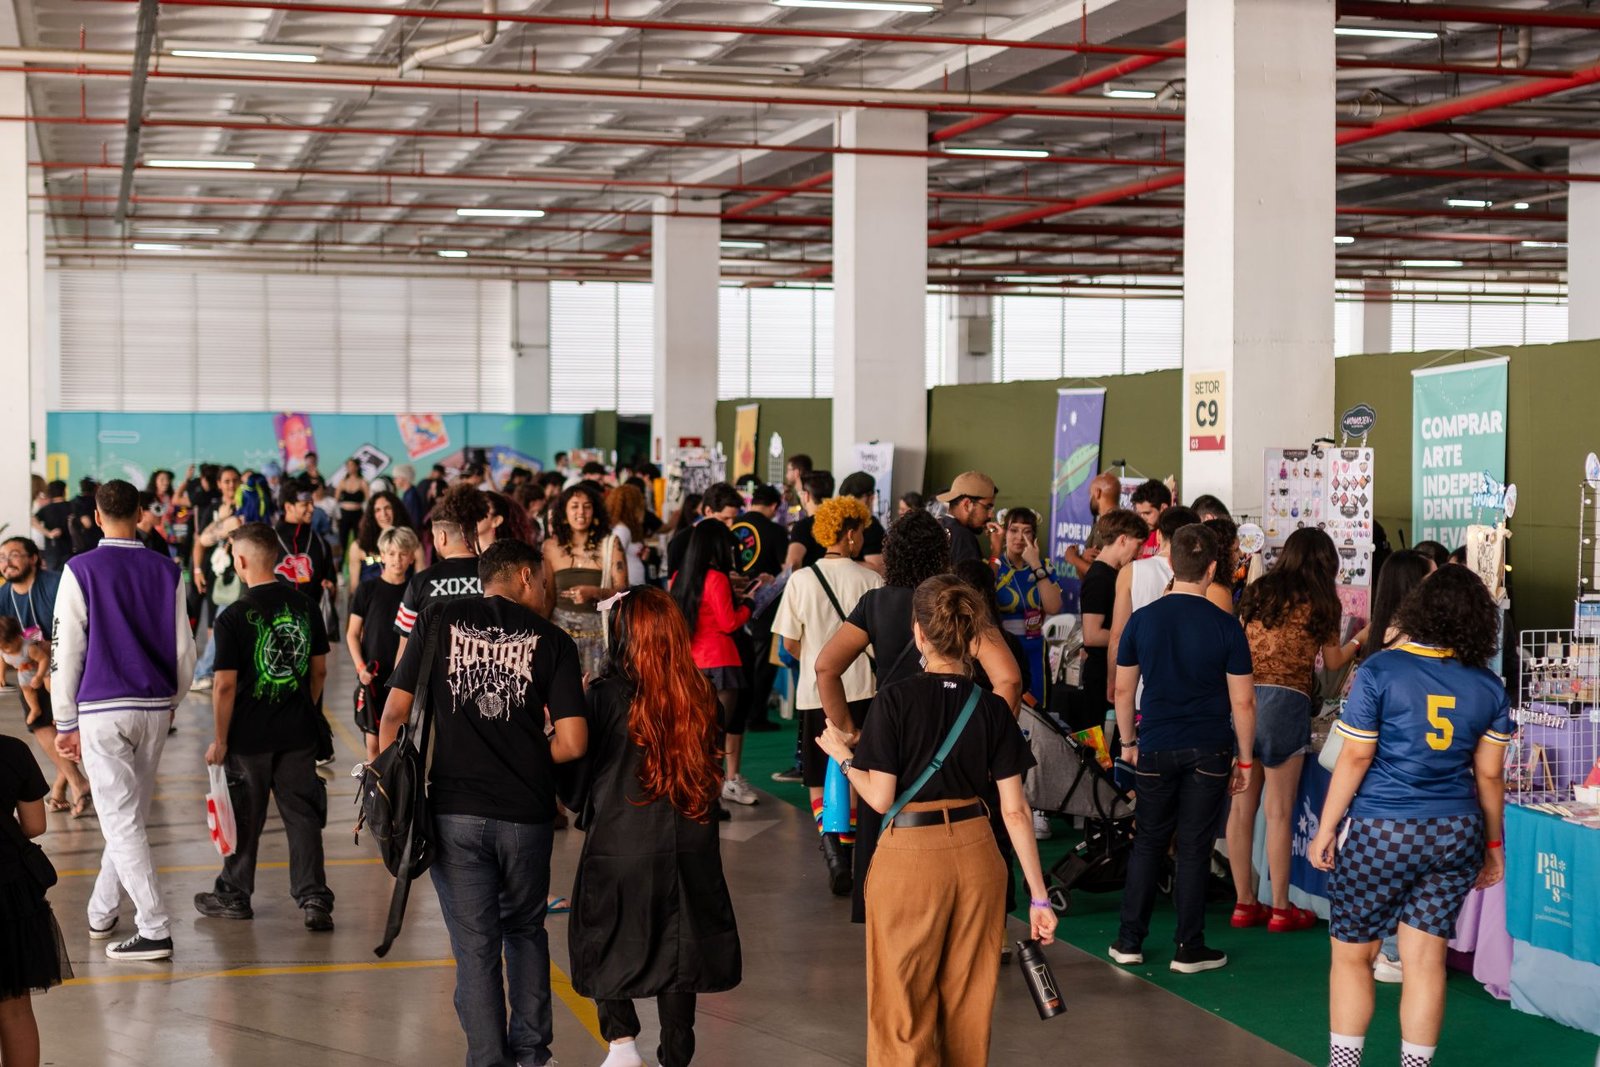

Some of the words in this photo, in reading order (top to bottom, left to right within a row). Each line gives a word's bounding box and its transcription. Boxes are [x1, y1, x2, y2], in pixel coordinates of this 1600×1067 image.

[1195, 381, 1220, 395] SETOR
[1196, 400, 1219, 427] C9
[1421, 410, 1503, 440] COMPRAR
[1422, 444, 1463, 469] ARTE
[1423, 496, 1473, 521] DENTE
[1057, 522, 1082, 540] APOIE
[447, 623, 542, 683] FUTURE
[1425, 694, 1456, 751] 5
